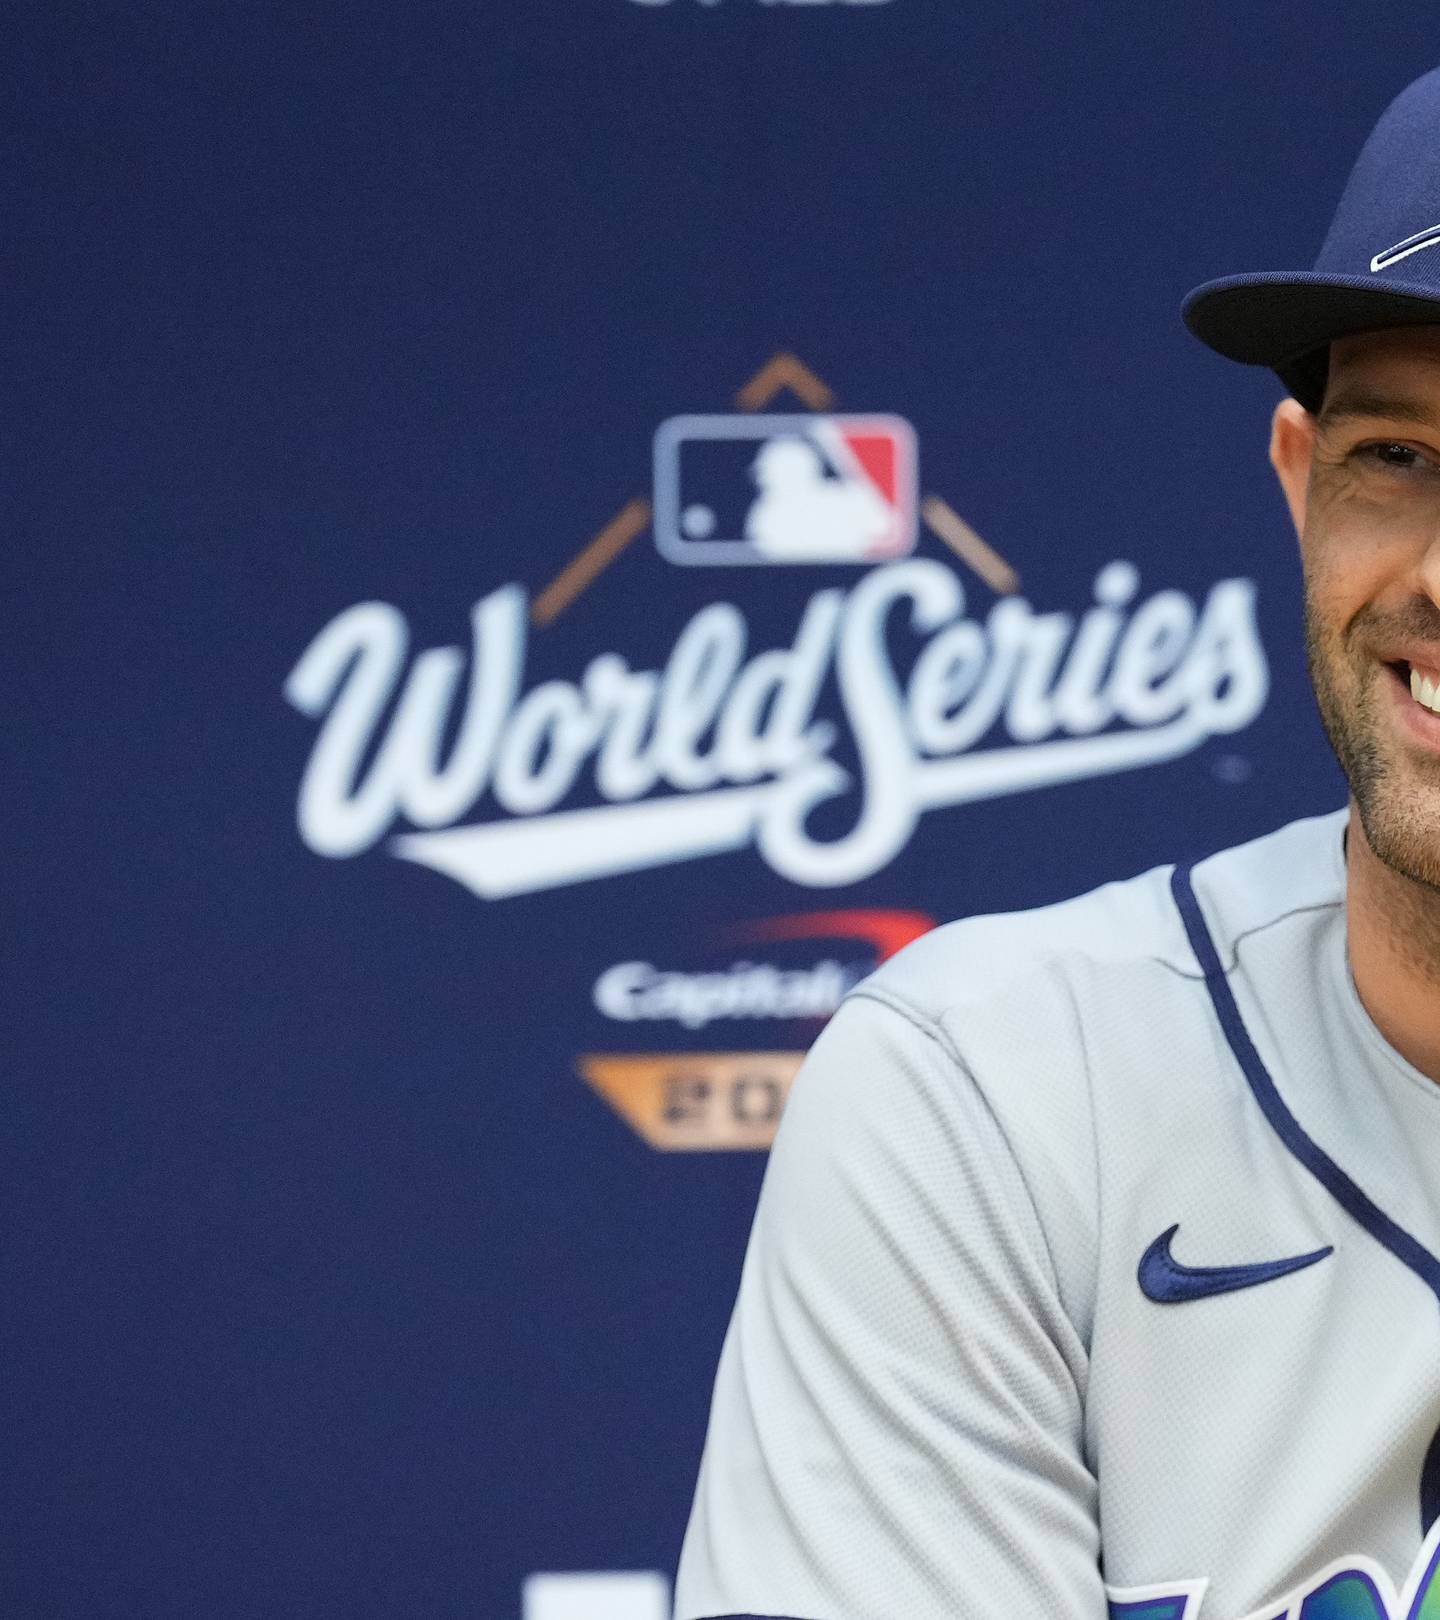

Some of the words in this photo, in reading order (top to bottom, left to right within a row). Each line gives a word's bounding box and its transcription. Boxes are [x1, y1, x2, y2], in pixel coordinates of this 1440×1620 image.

[285, 584, 842, 858] World
[755, 558, 1268, 888] Series
[662, 1074, 782, 1124] 20
